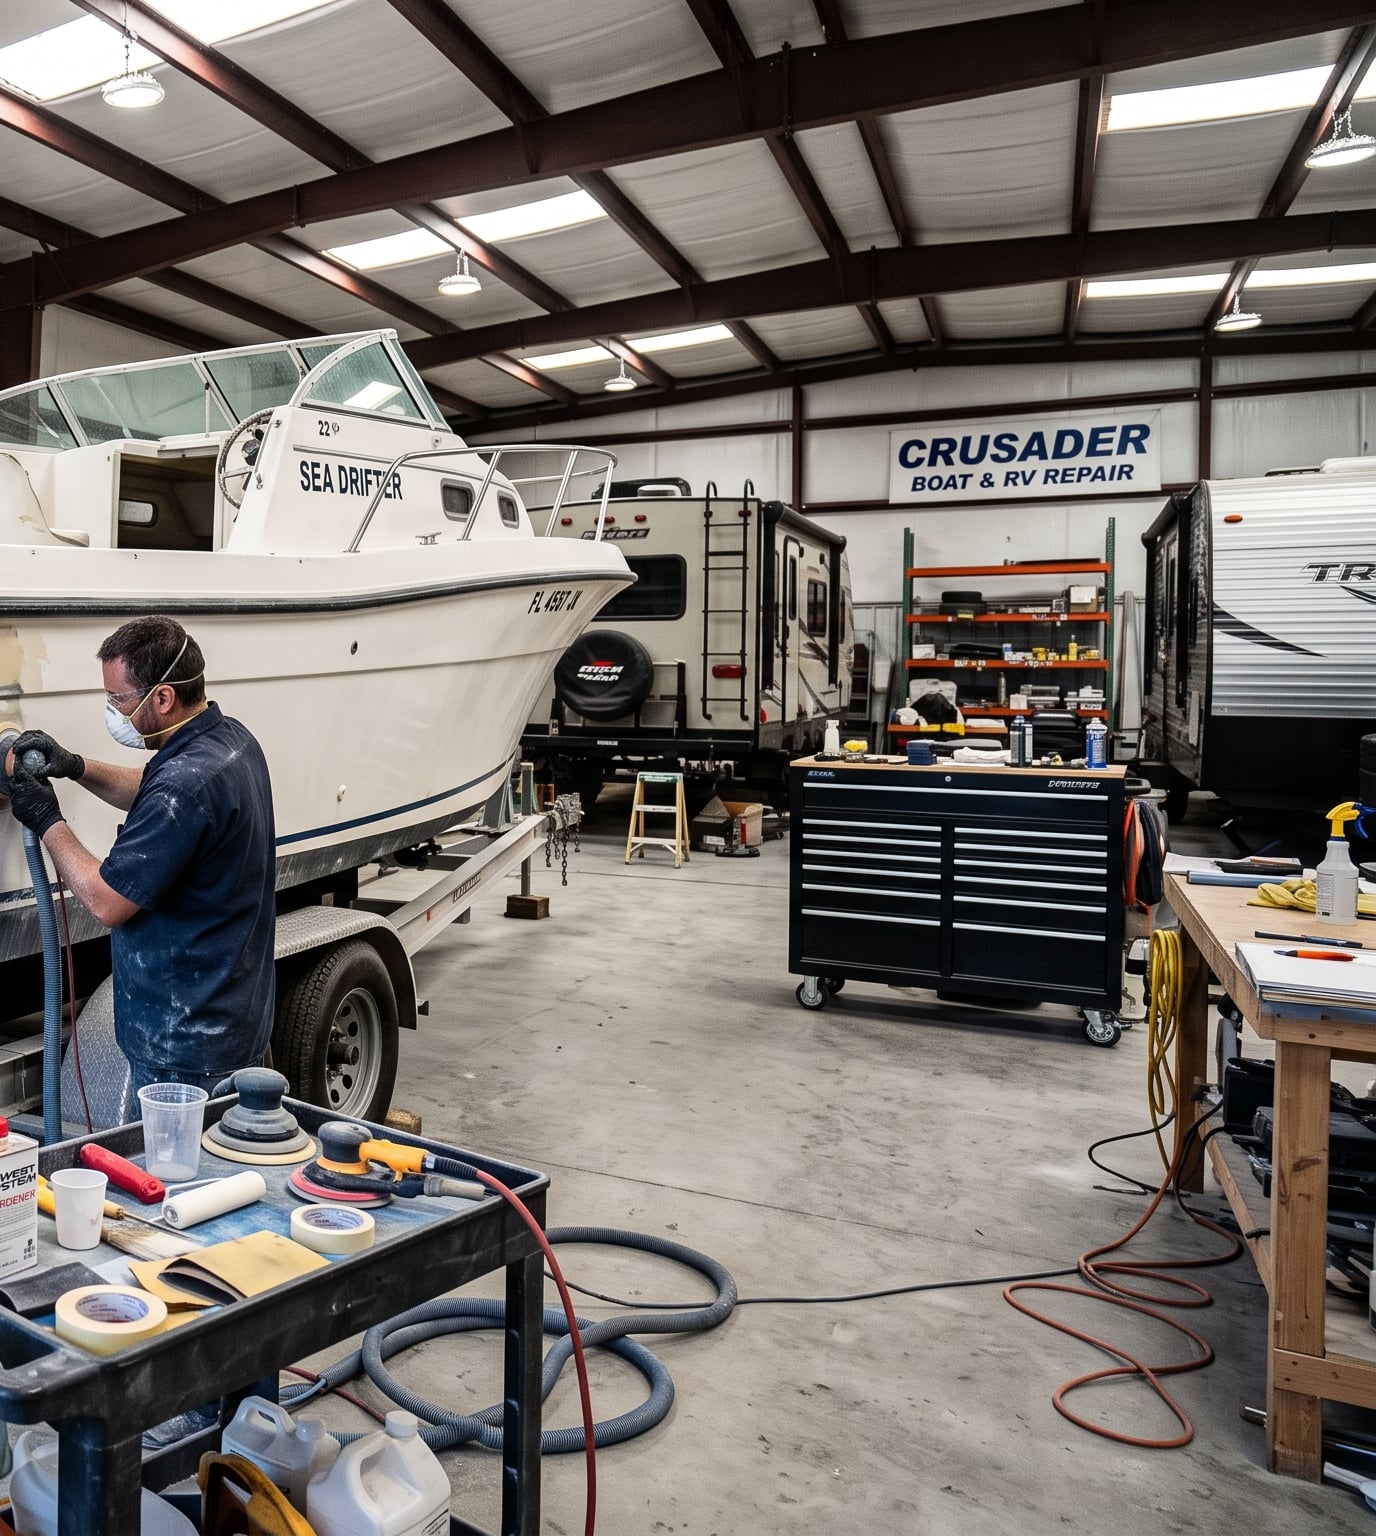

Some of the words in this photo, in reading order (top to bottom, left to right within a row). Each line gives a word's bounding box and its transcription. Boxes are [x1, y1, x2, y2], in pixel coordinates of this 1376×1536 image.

[898, 423, 1151, 469] CRUSADER
[300, 460, 334, 493] SEA
[338, 465, 403, 500] DRIFTER
[911, 473, 973, 492] BOAT
[979, 473, 995, 489] &
[1003, 470, 1037, 487] RV
[1043, 463, 1135, 485] REPAIR
[528, 591, 544, 614] FL
[0, 1163, 35, 1182] WEST
